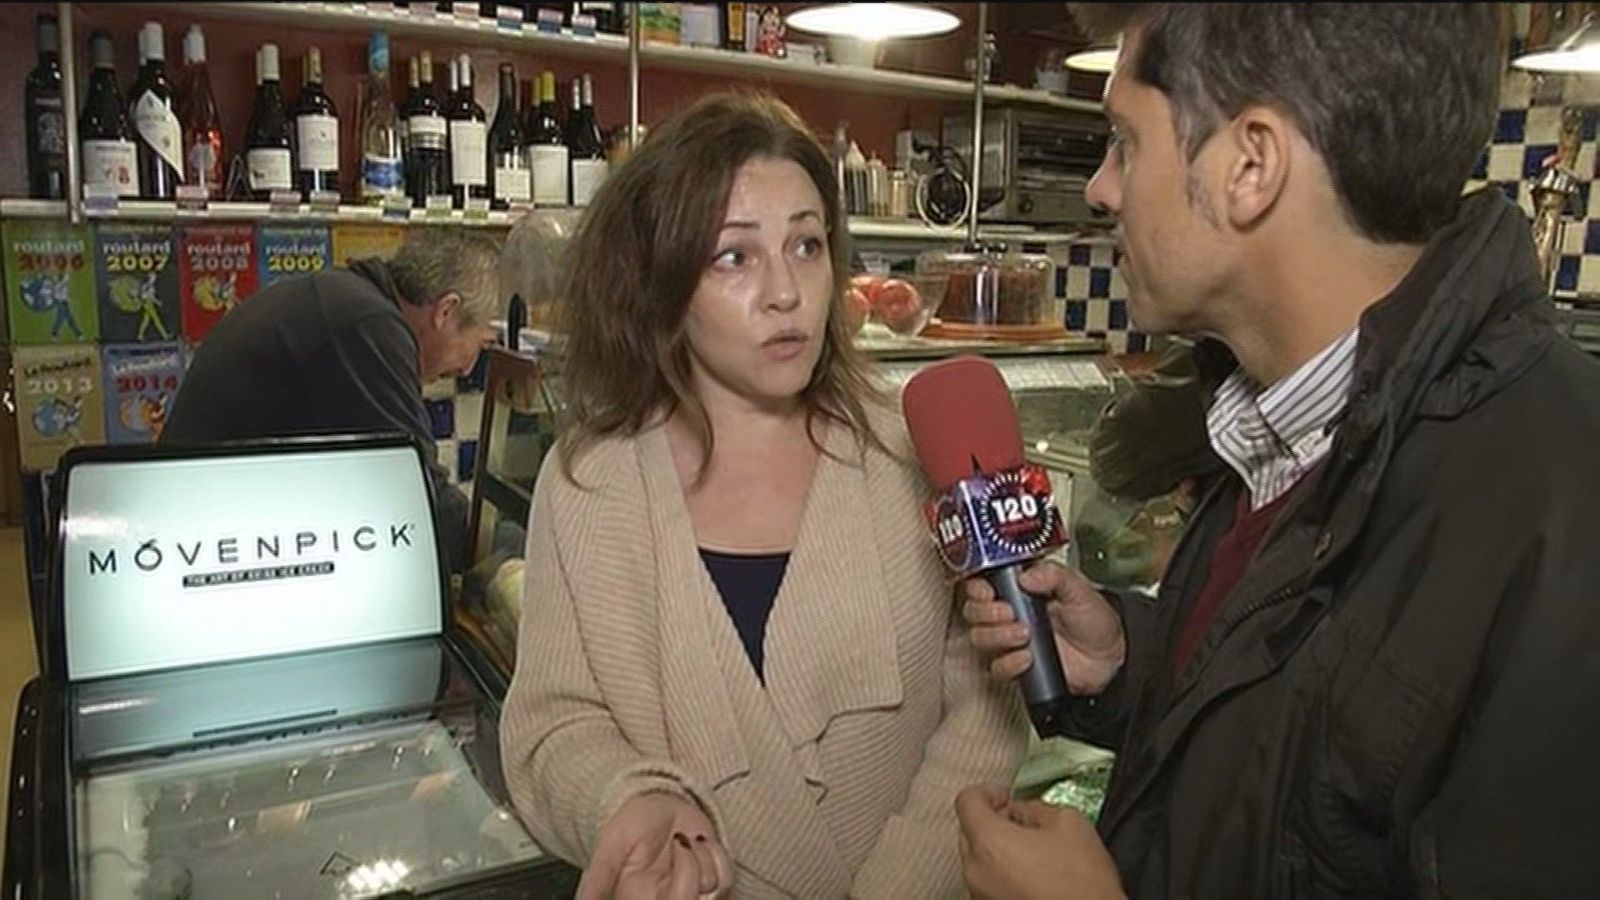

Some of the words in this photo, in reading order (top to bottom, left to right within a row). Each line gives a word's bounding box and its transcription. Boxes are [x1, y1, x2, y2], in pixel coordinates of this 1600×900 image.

[103, 240, 171, 254] routard
[187, 241, 251, 255] routard
[265, 242, 326, 255] routard
[106, 253, 170, 271] 2007
[190, 256, 249, 271] 2008
[267, 255, 325, 271] 2009
[27, 376, 92, 394] 2013
[991, 494, 1038, 523] 120
